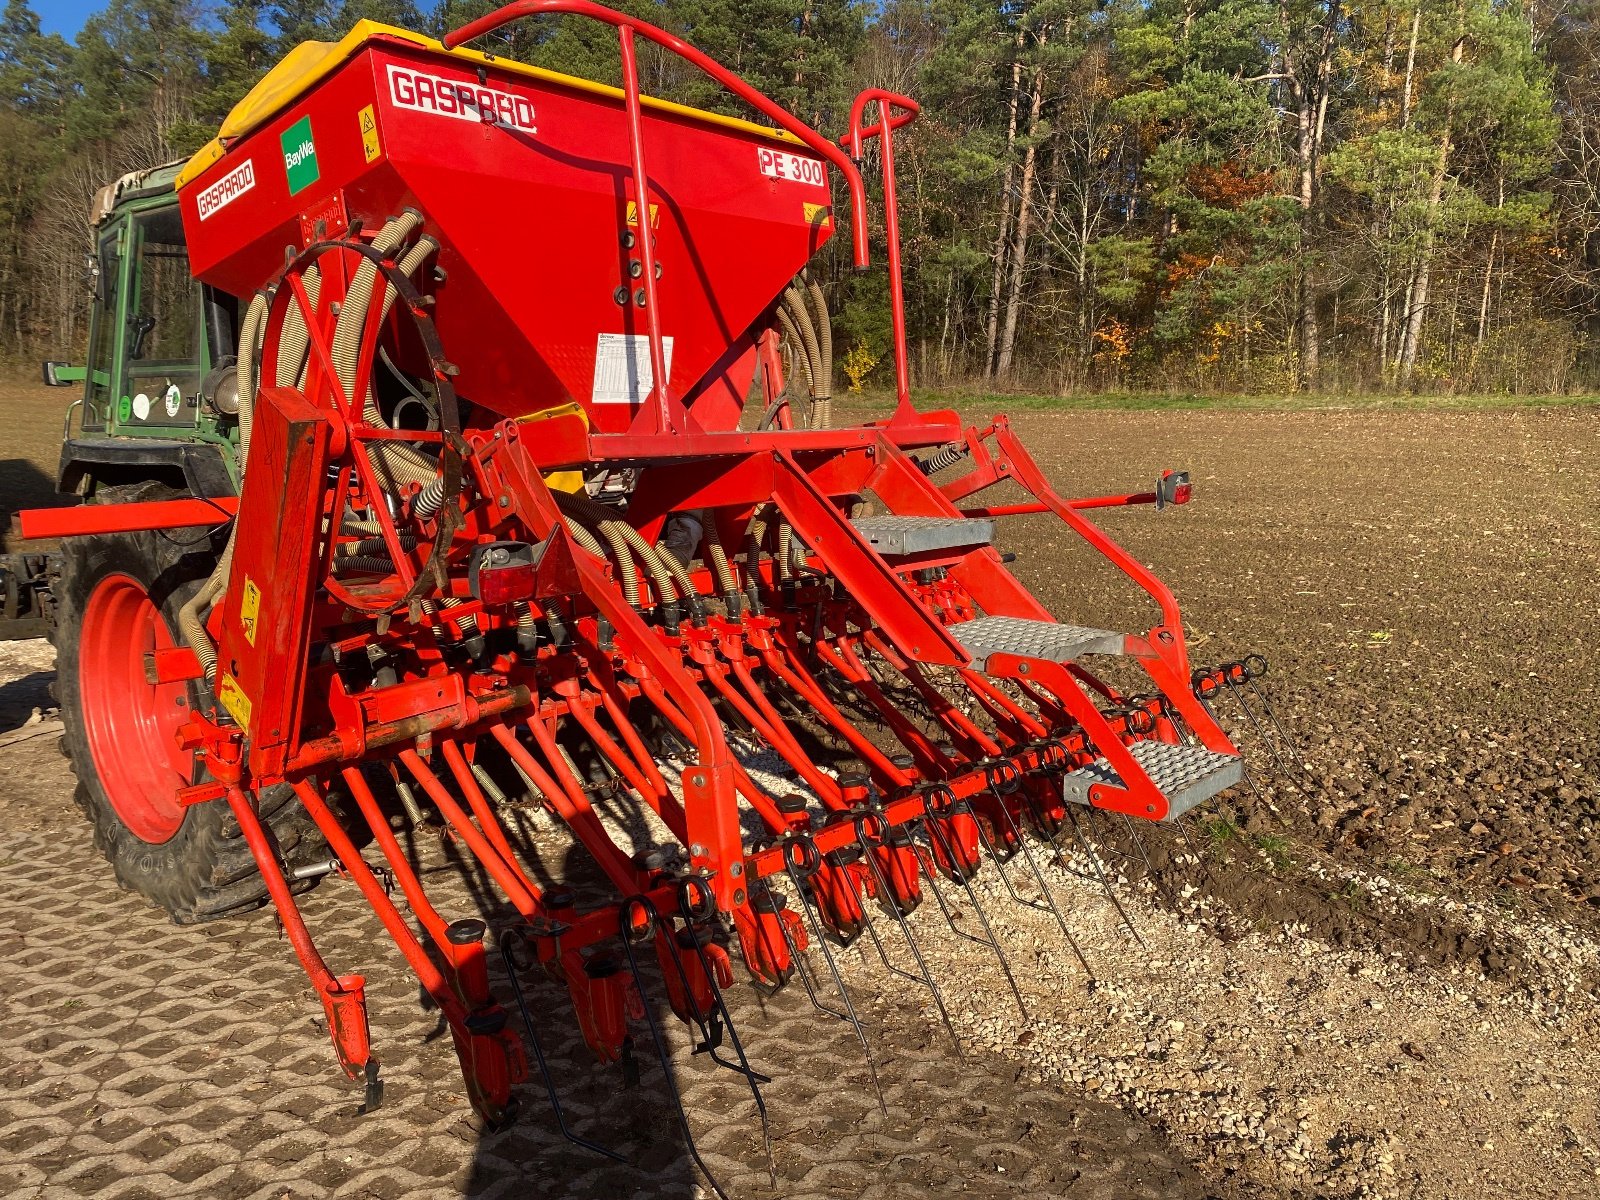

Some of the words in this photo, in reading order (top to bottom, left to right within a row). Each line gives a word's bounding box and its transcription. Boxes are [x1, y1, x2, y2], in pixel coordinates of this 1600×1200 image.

[285, 140, 314, 170] BayWa
[760, 151, 786, 177] PE
[791, 157, 822, 184] 300
[199, 164, 252, 216] GASPARDO
